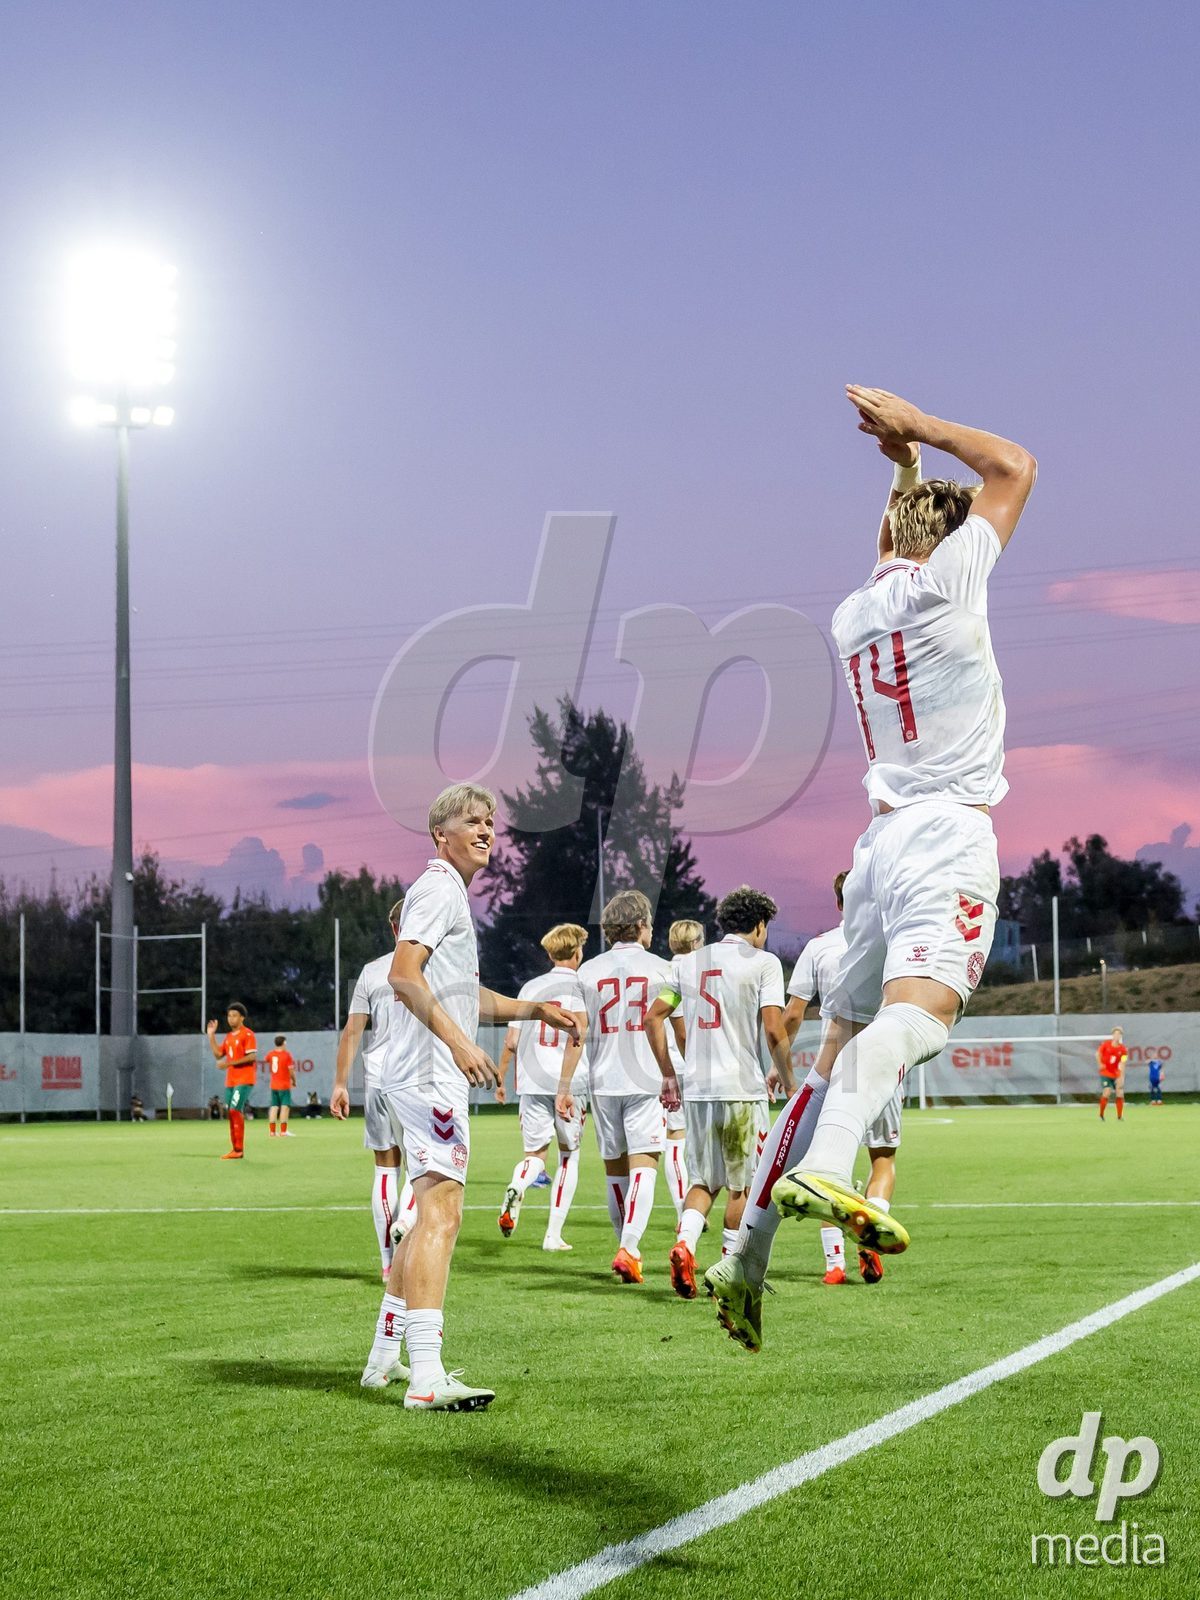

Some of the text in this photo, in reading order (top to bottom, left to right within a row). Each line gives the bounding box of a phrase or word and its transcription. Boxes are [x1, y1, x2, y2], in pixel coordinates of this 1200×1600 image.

[848, 630, 919, 762] 14
[596, 975, 649, 1034] 23
[697, 968, 723, 1030] 5
